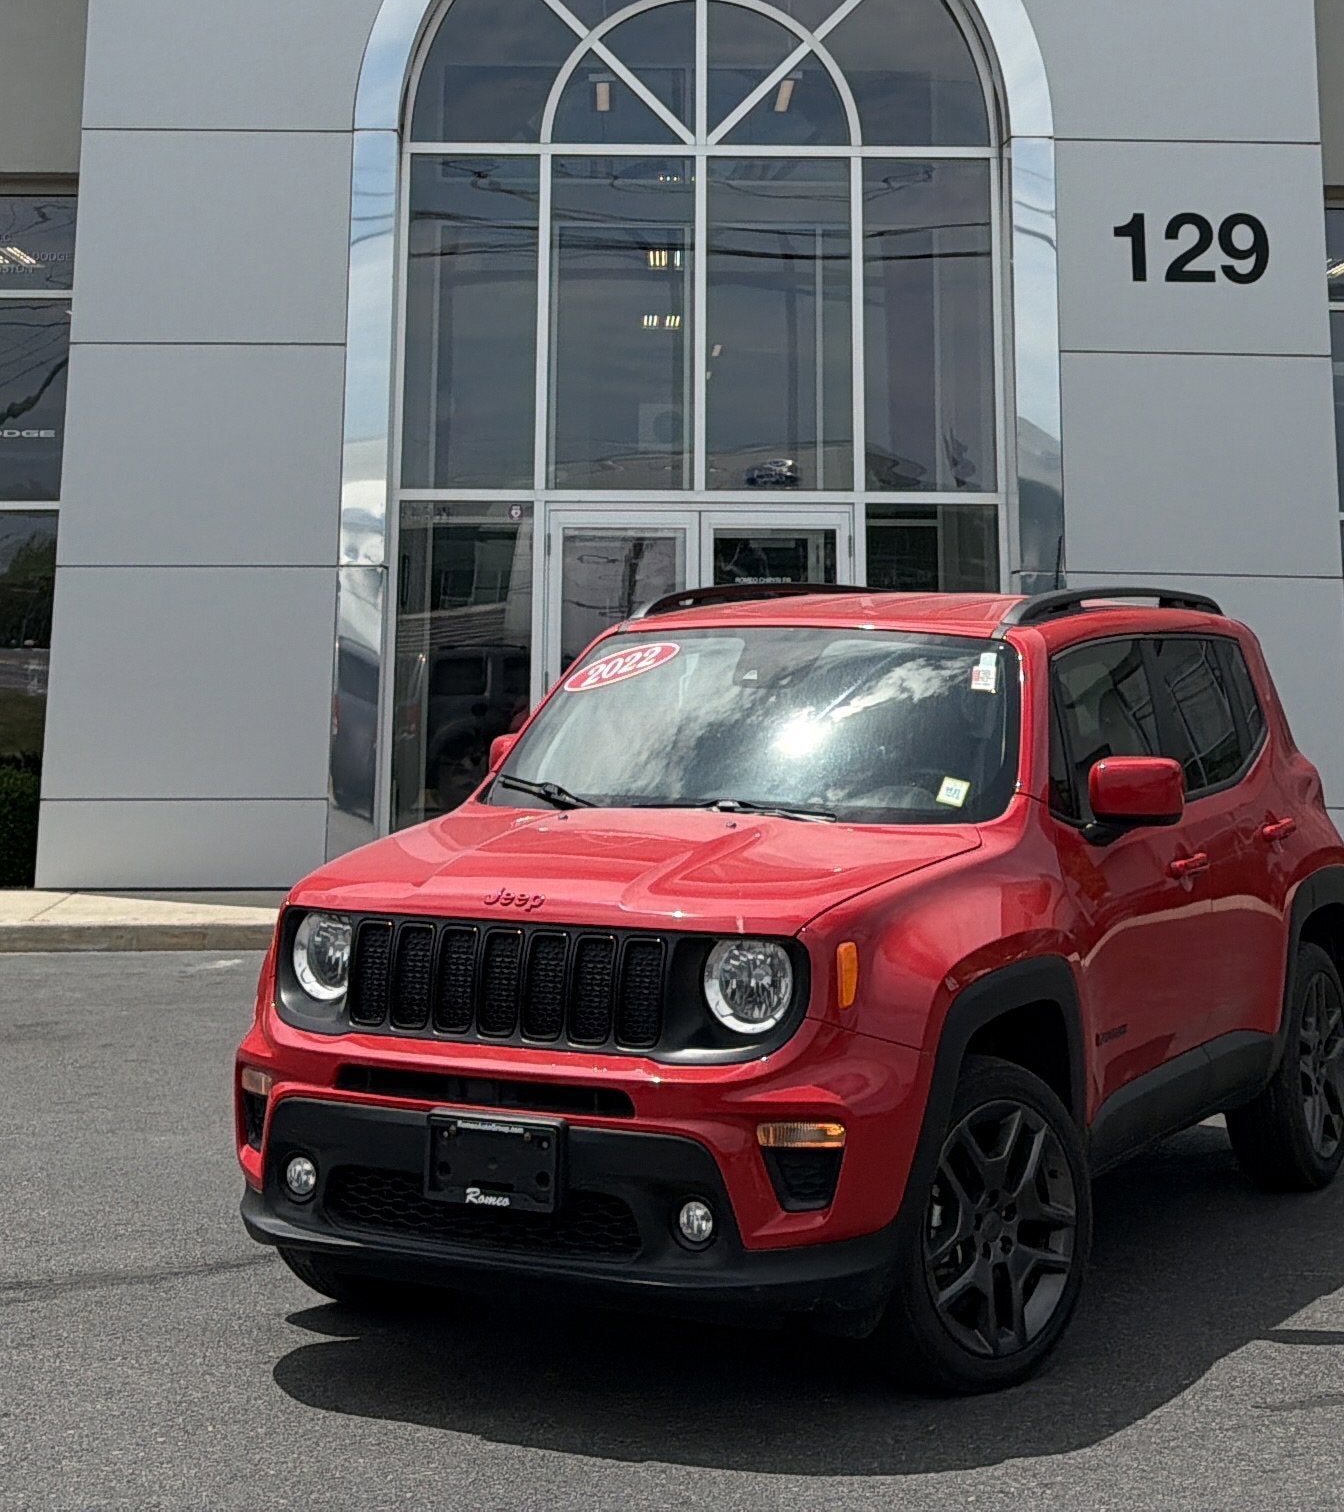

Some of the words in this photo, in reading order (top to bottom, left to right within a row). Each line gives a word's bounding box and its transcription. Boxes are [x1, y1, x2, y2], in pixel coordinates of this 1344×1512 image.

[1112, 211, 1270, 285] 129
[581, 646, 662, 688] 2022
[483, 887, 545, 913] Jeep
[465, 1187, 510, 1207] Romeo
